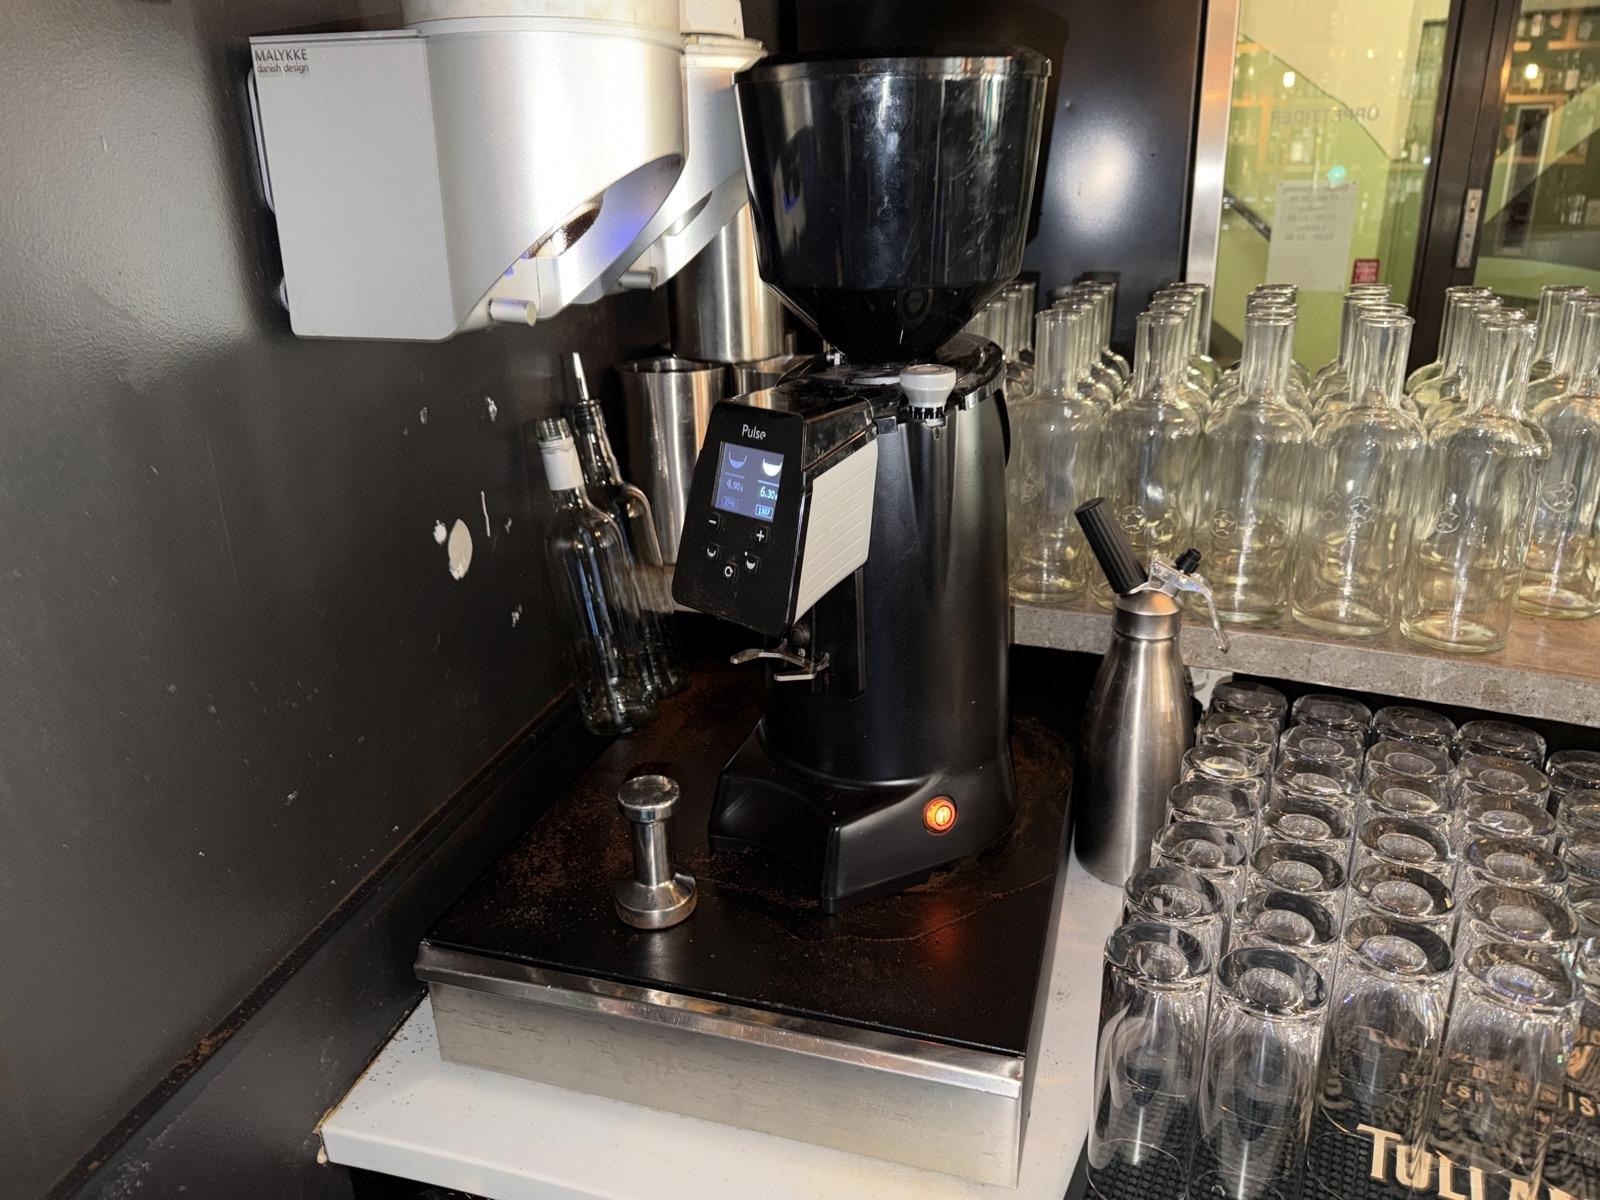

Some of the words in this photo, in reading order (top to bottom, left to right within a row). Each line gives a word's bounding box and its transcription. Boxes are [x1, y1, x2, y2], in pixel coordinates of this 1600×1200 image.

[254, 48, 308, 61] MALYKKE
[257, 63, 282, 73] danish
[284, 63, 310, 74] design
[741, 423, 767, 440] Pulse
